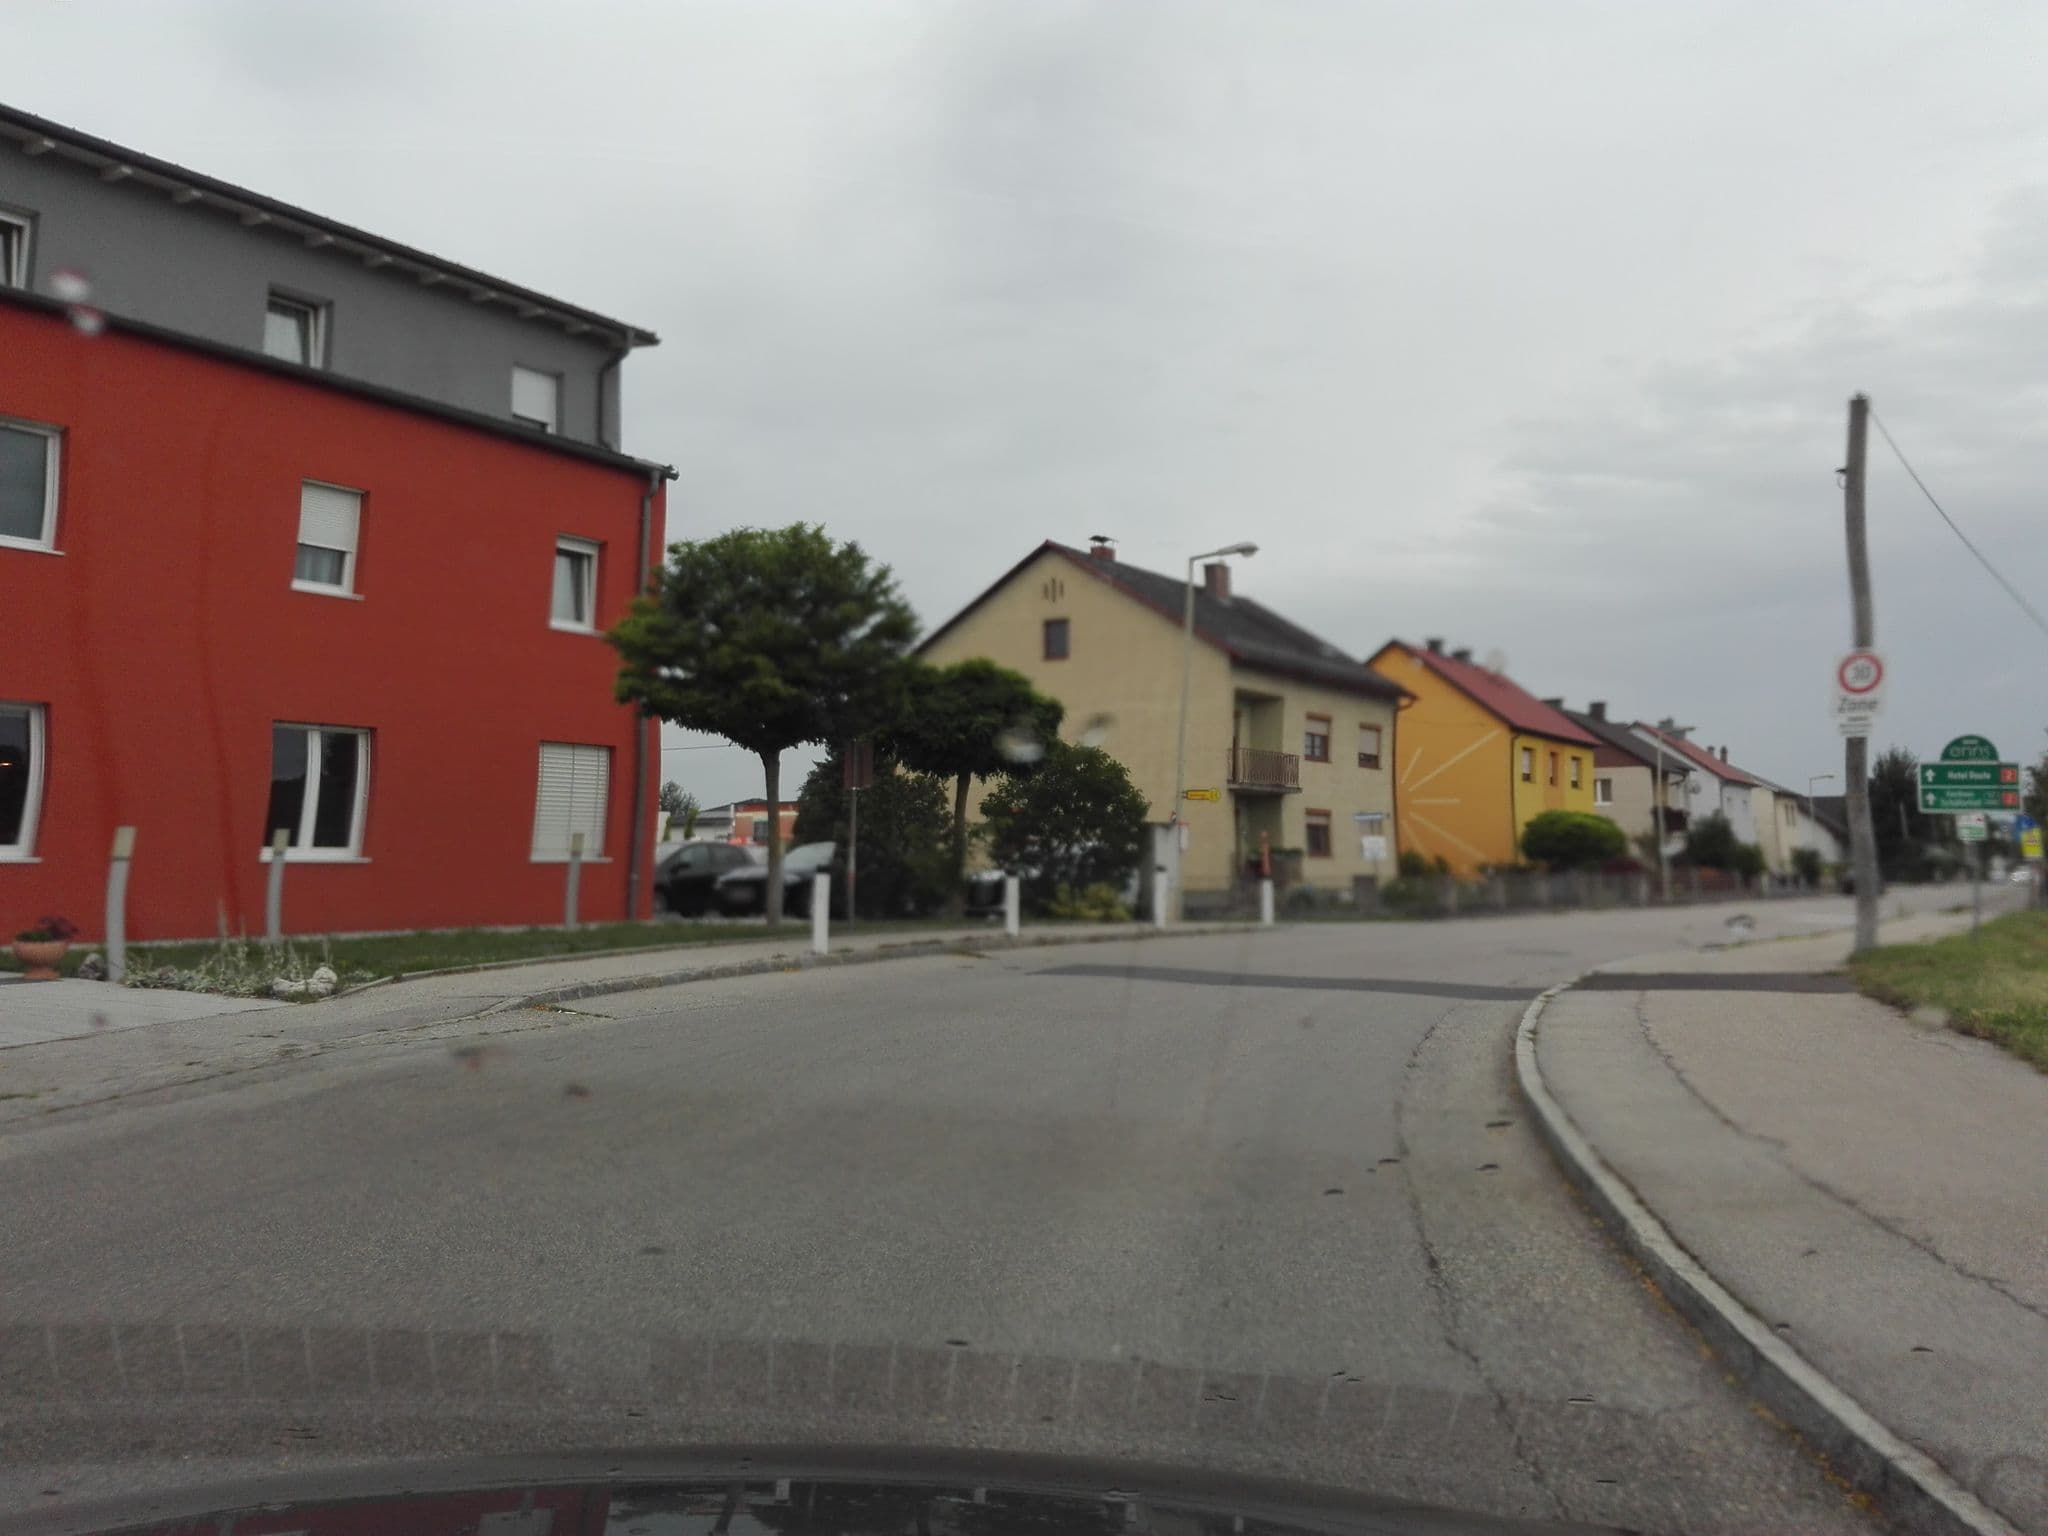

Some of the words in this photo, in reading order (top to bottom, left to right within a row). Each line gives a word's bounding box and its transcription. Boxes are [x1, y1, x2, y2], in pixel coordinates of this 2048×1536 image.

[1852, 665, 1871, 681] 30
[1838, 698, 1878, 713] Zone
[1947, 771, 1968, 780] Hotel
